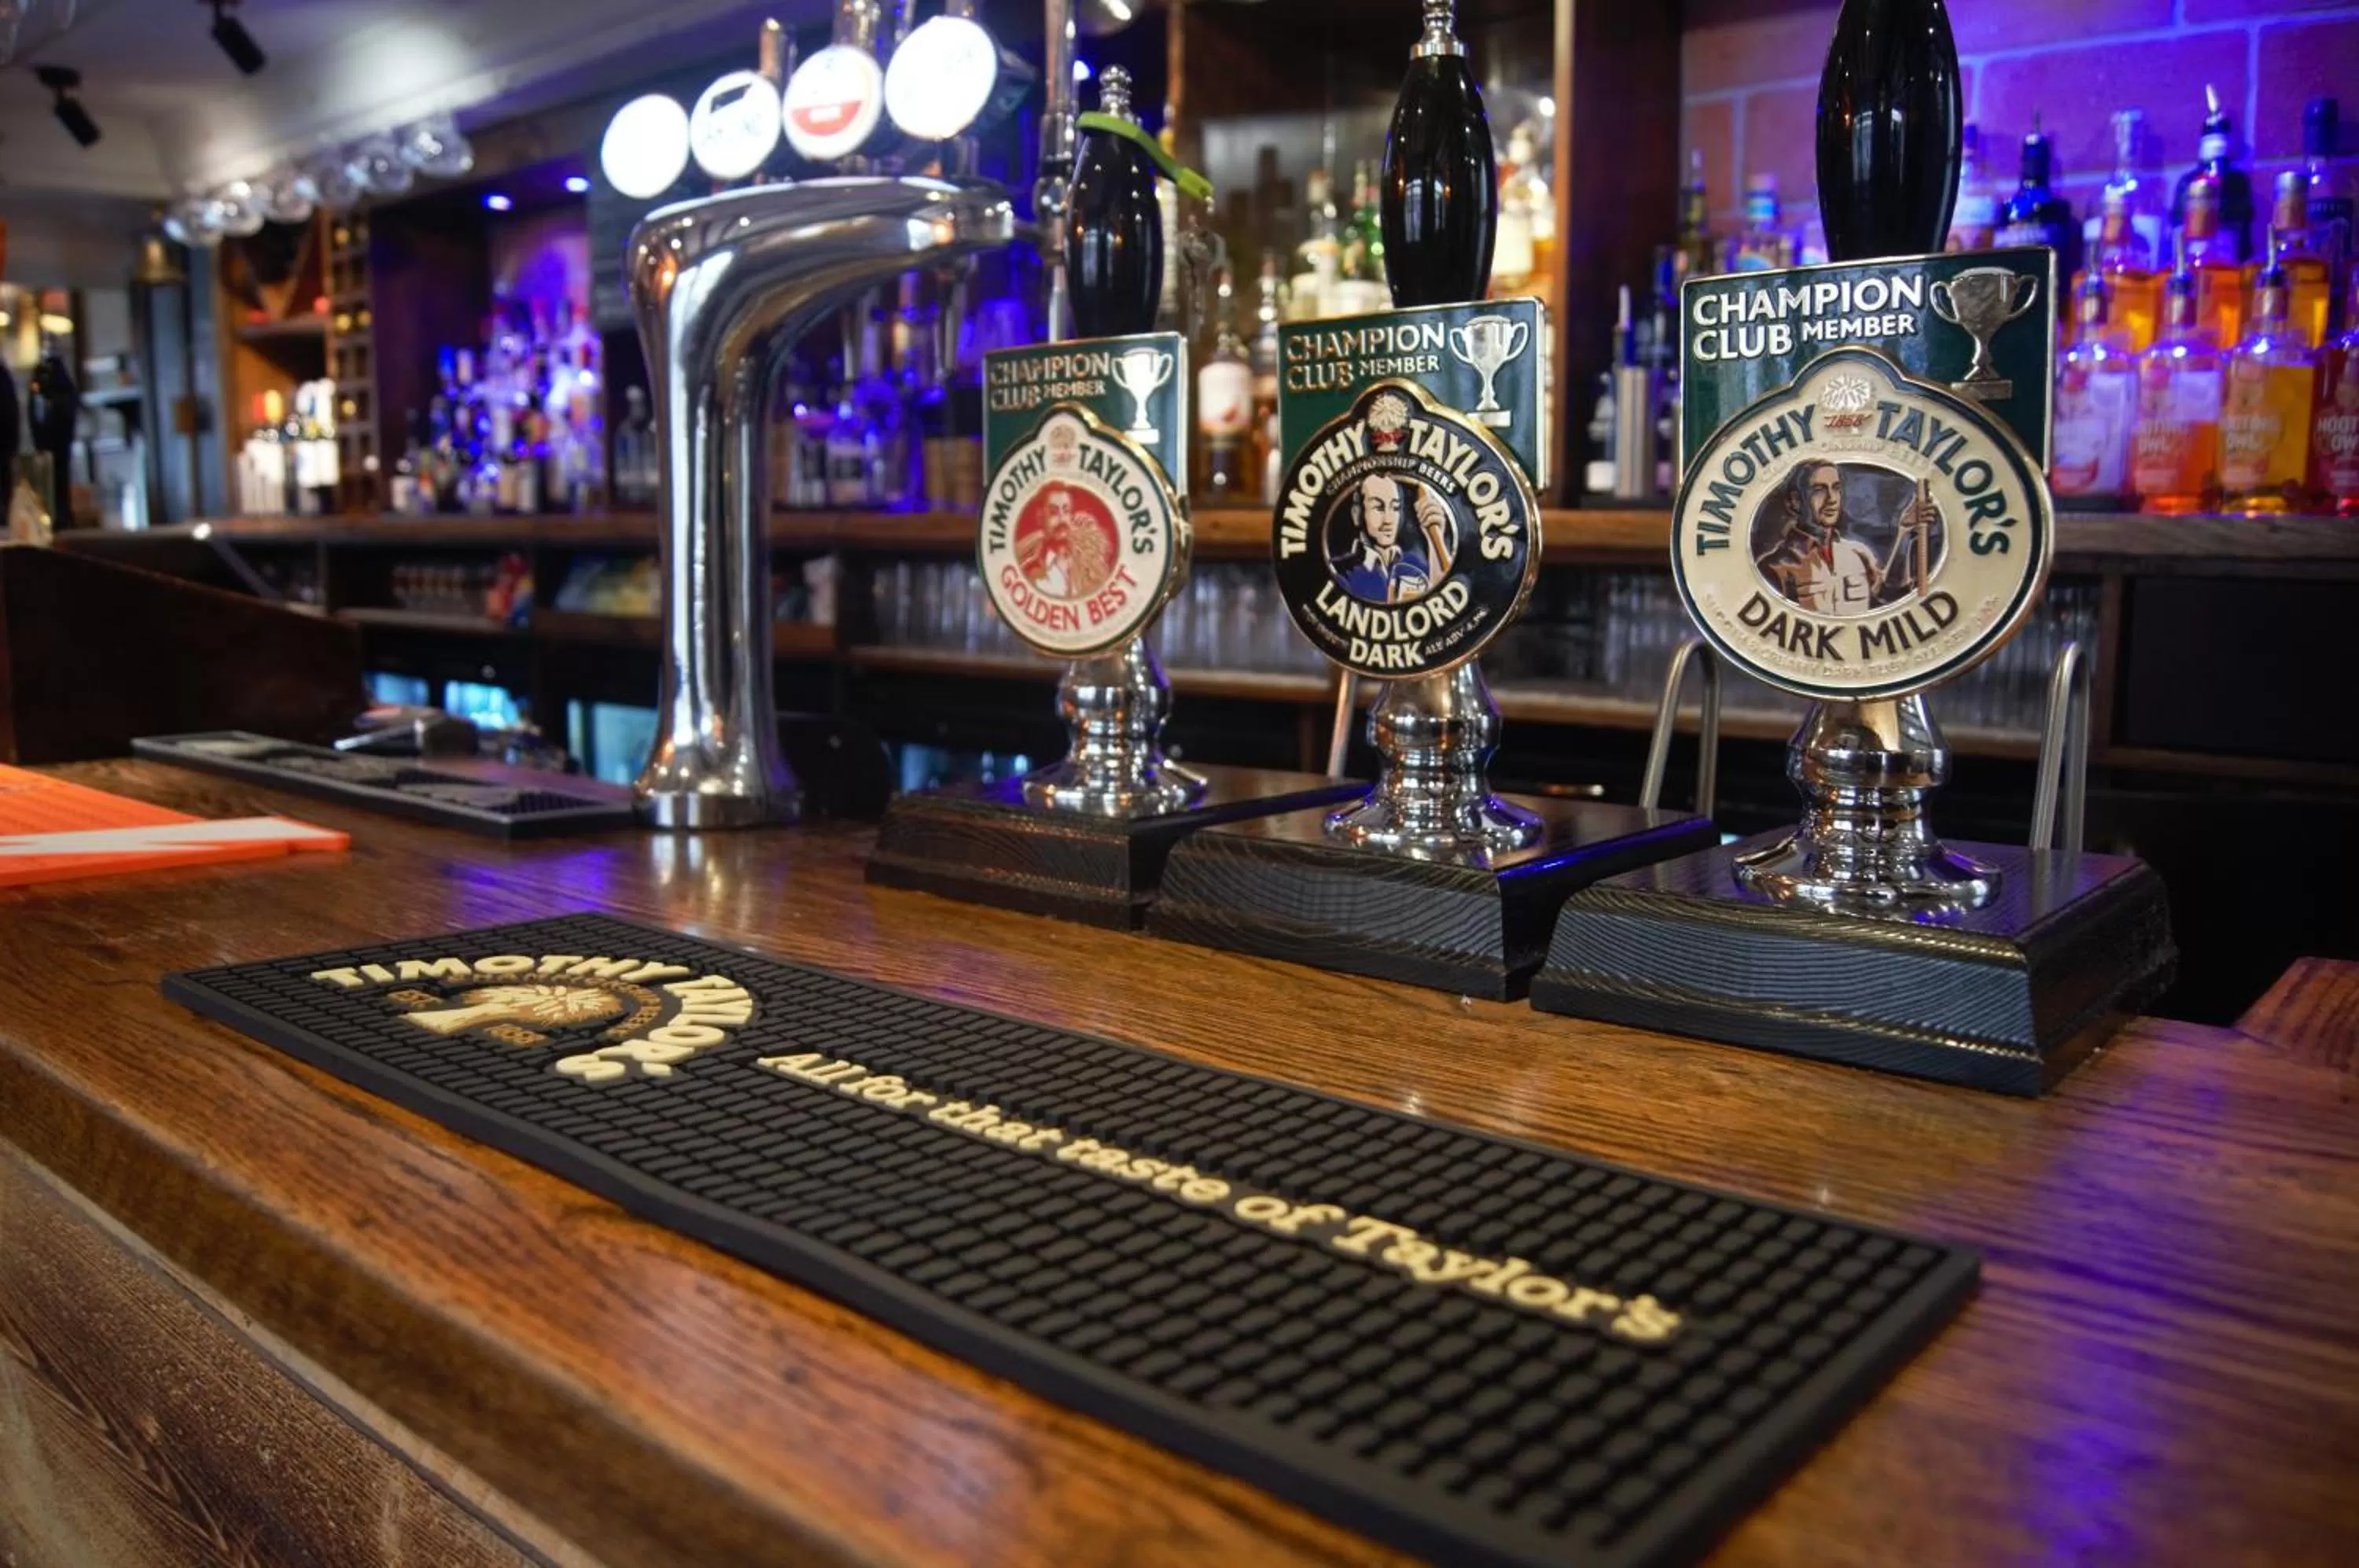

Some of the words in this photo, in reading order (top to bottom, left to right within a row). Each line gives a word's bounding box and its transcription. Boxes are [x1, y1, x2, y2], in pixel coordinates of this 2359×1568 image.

[1694, 274, 1923, 326] CHAMPION
[1285, 322, 1445, 361] CHAMPION
[1695, 326, 1793, 360] CLUB
[1802, 313, 1916, 341] MEMBER
[990, 352, 1110, 385] CHAMPION
[1286, 363, 1354, 391] CLUB
[1360, 354, 1441, 377] MEMBER
[991, 385, 1042, 410] CLUB
[1043, 380, 1106, 398] MEMBER
[988, 443, 1047, 554] TIMOTHY
[1076, 443, 1159, 555] TAYLOR'S
[1281, 418, 1366, 560] TIMOTHY
[1409, 418, 1515, 561] TAYLOR'S
[1326, 455, 1416, 496] CHAMPIONSHIP
[1419, 462, 1456, 495] BEERS
[1696, 403, 1816, 557] TIMOTHY
[1876, 400, 2019, 557] TAYLOR'S
[1001, 564, 1081, 631] GOLDEN
[1085, 563, 1138, 625] BEST
[1315, 580, 1470, 641] LANDLORD
[1737, 590, 1846, 661] DARK
[1857, 591, 1959, 660] MILD
[1349, 637, 1426, 668] DARK
[311, 955, 690, 987] TIMOTHY
[756, 1052, 866, 1085] All
[838, 1075, 937, 1110] for
[1056, 1138, 1231, 1204] taste
[1235, 1195, 1345, 1234] of
